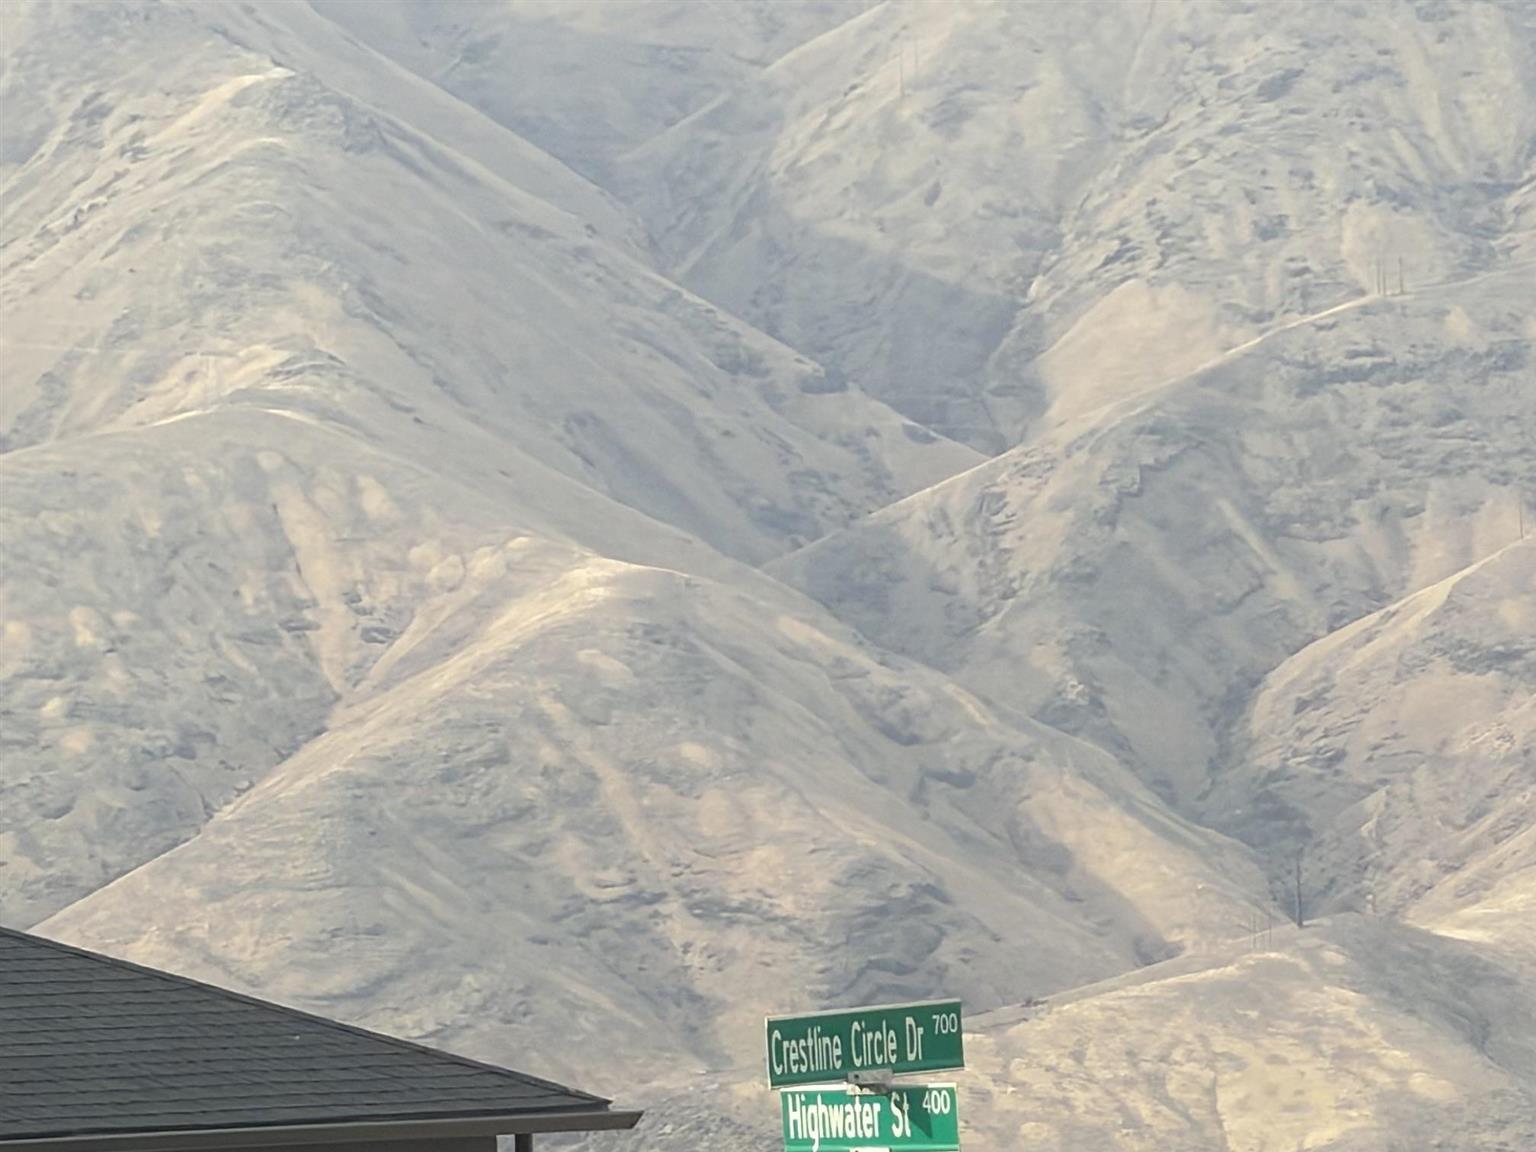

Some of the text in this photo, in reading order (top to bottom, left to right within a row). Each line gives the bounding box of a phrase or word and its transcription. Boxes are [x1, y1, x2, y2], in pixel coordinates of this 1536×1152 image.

[932, 1013, 958, 1034] 700
[771, 1016, 924, 1075] Crestline Circle Dr
[787, 1091, 911, 1152] Highwater St
[922, 1090, 951, 1114] 400
